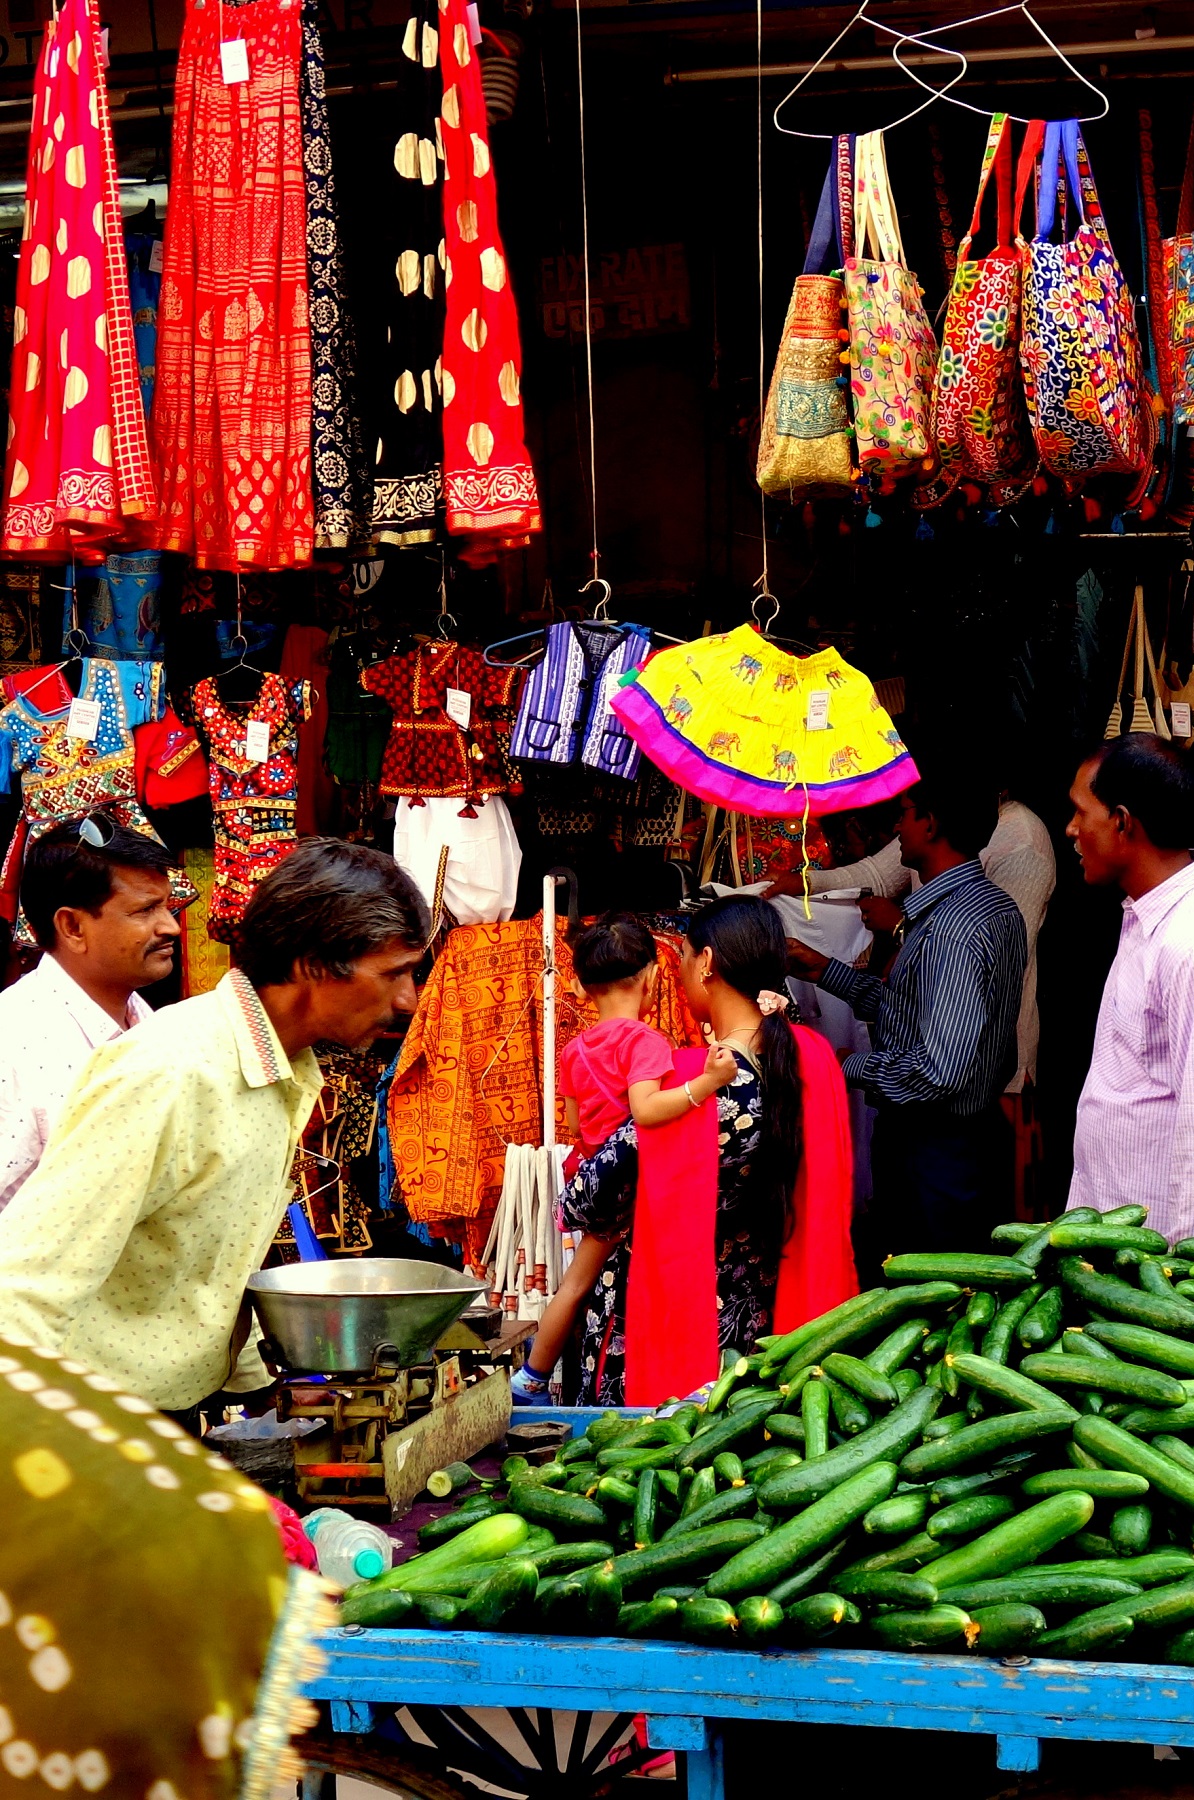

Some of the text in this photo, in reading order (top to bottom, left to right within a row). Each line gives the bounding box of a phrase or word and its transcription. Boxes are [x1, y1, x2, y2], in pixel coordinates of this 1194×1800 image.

[540, 241, 686, 293] FIX RATE
[541, 289, 690, 339] एक दाम
